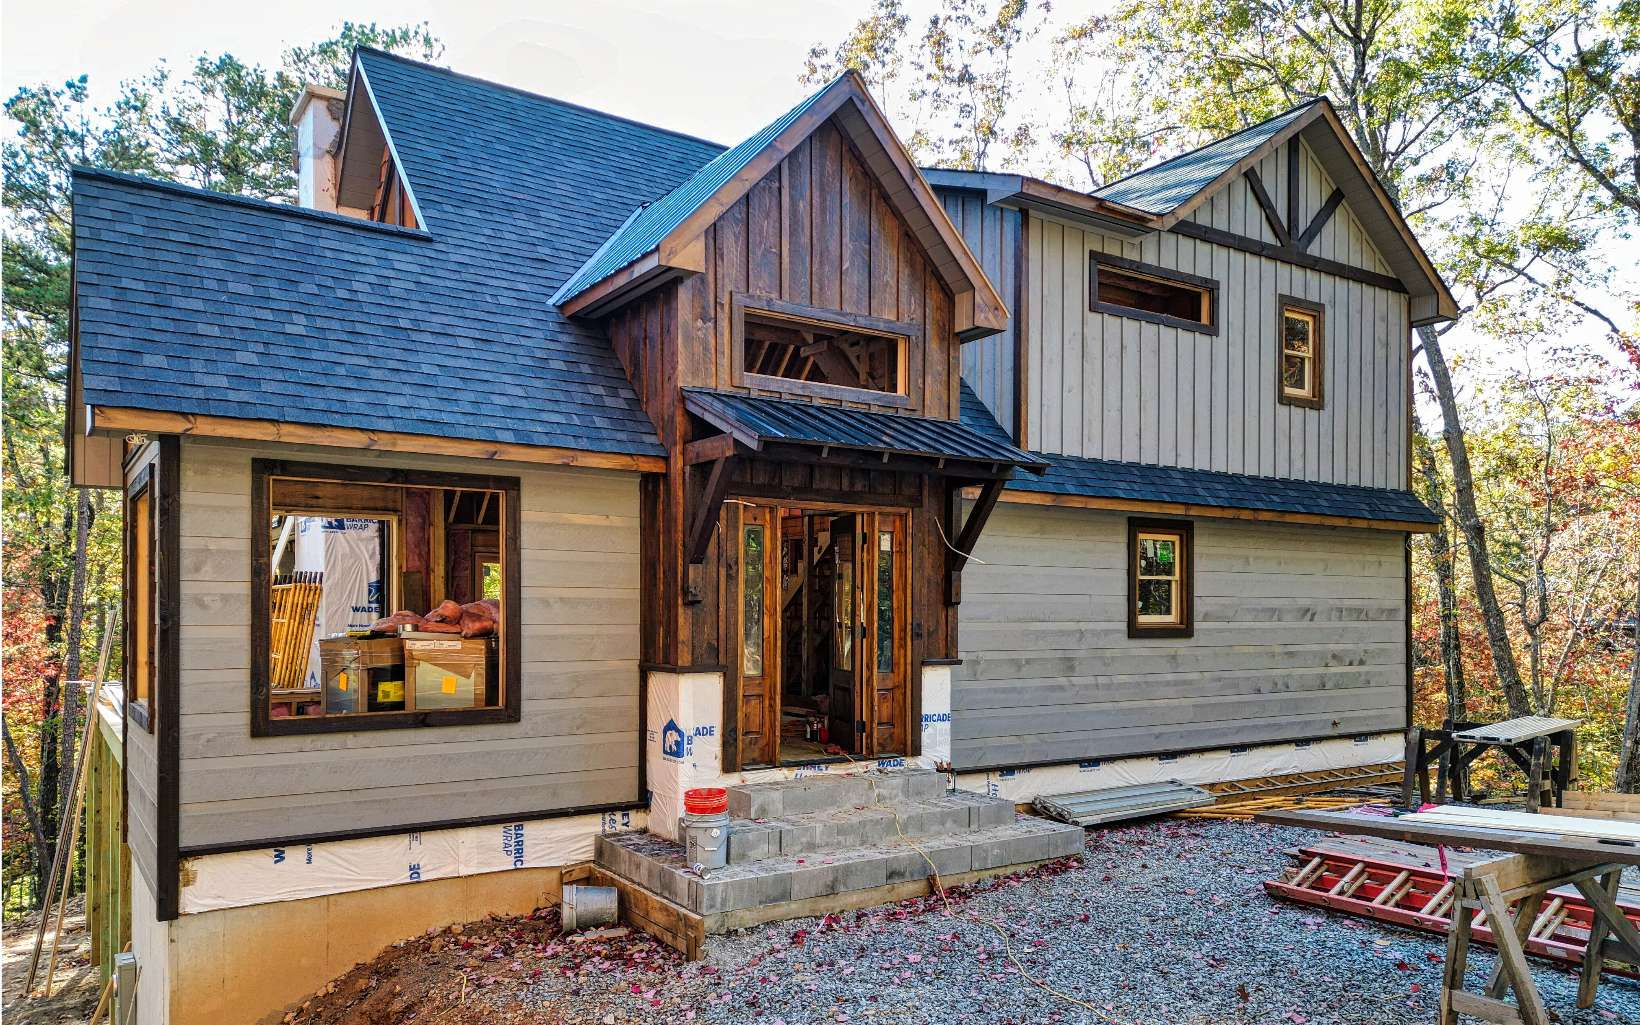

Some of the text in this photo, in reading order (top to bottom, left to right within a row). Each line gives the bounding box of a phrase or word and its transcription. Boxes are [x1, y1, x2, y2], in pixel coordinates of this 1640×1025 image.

[345, 523, 369, 531] WRAP
[877, 757, 905, 768] WADE
[502, 825, 513, 857] WRAP
[513, 823, 524, 868] BARRIC
